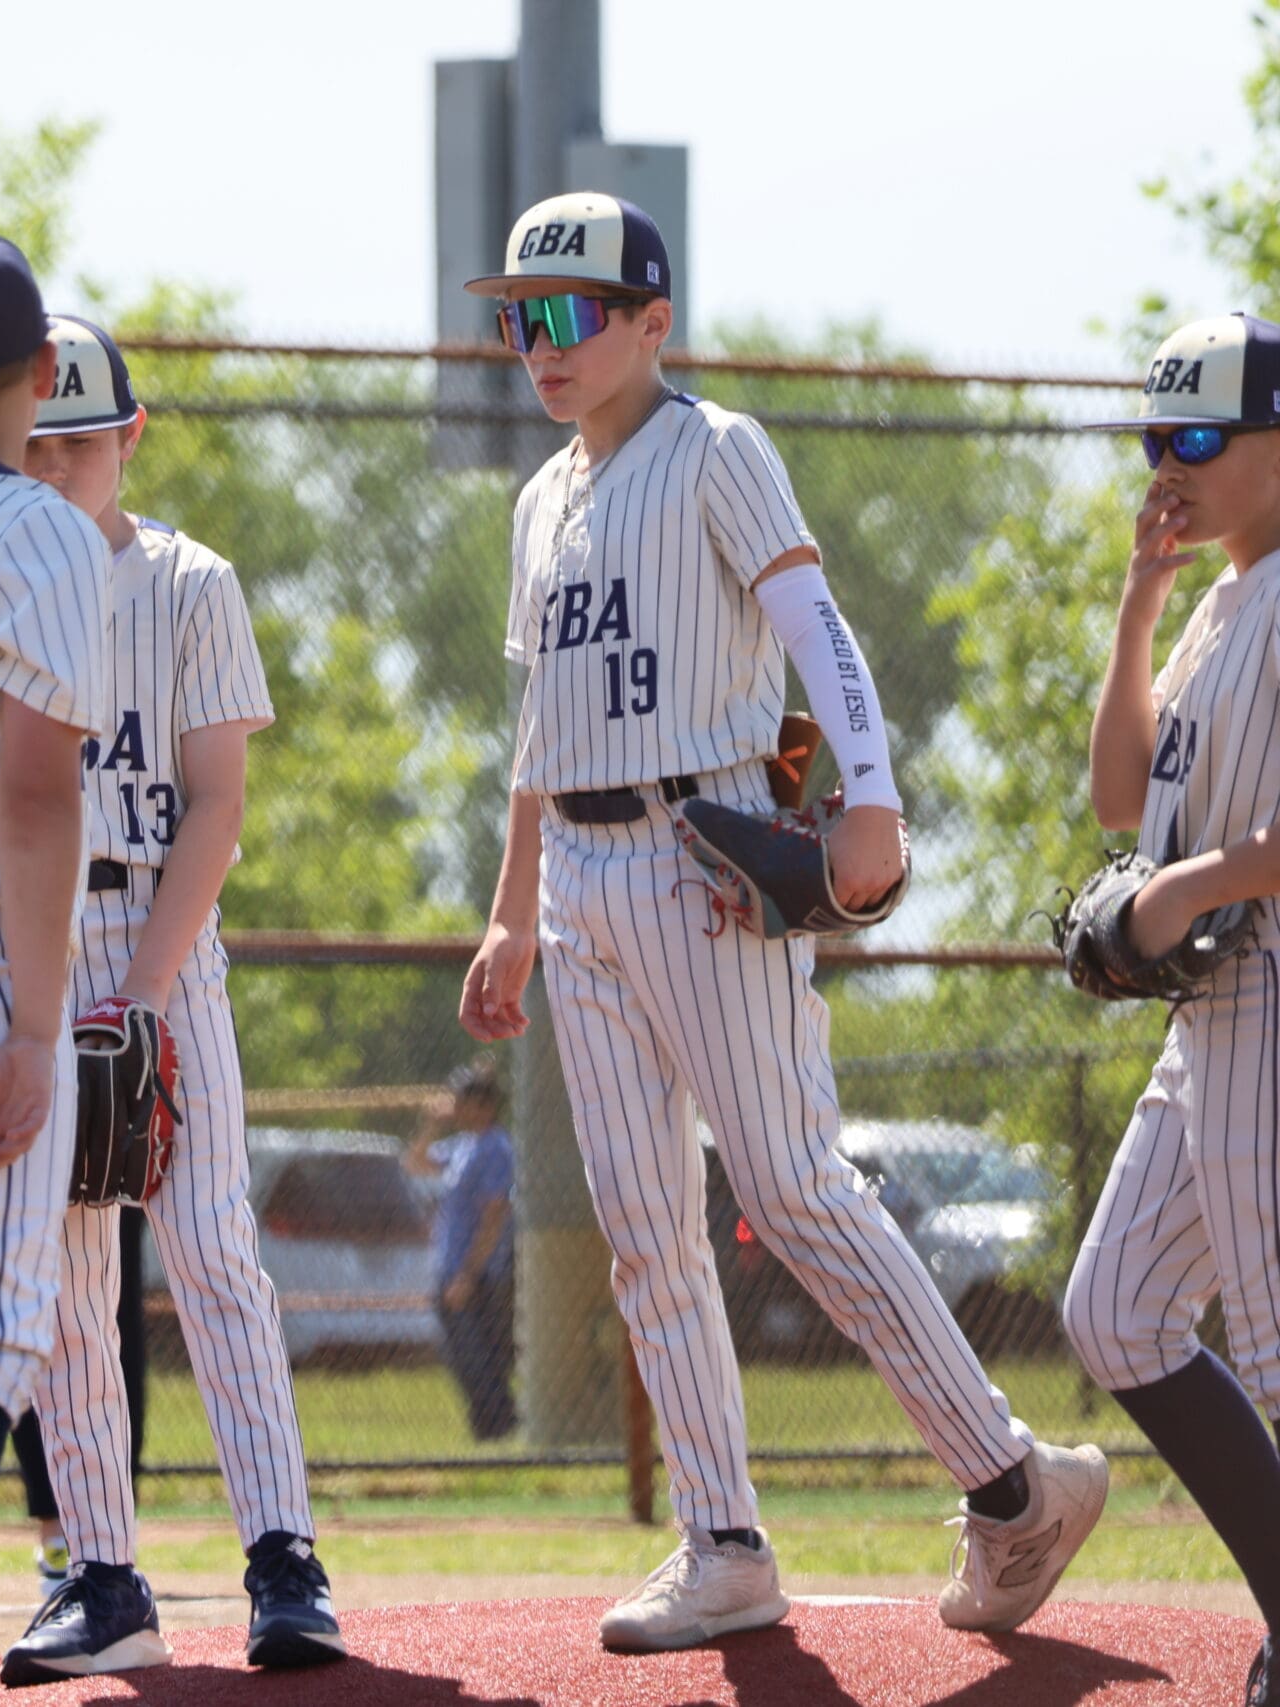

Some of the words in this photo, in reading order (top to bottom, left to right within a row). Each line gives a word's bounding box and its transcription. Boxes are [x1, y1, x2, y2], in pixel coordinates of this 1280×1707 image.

[518, 224, 587, 261] GBA
[1144, 359, 1203, 395] GBA
[605, 648, 658, 720] 19
[838, 662, 861, 682] BY
[842, 685, 870, 733] JESUS
[120, 783, 176, 846] 13
